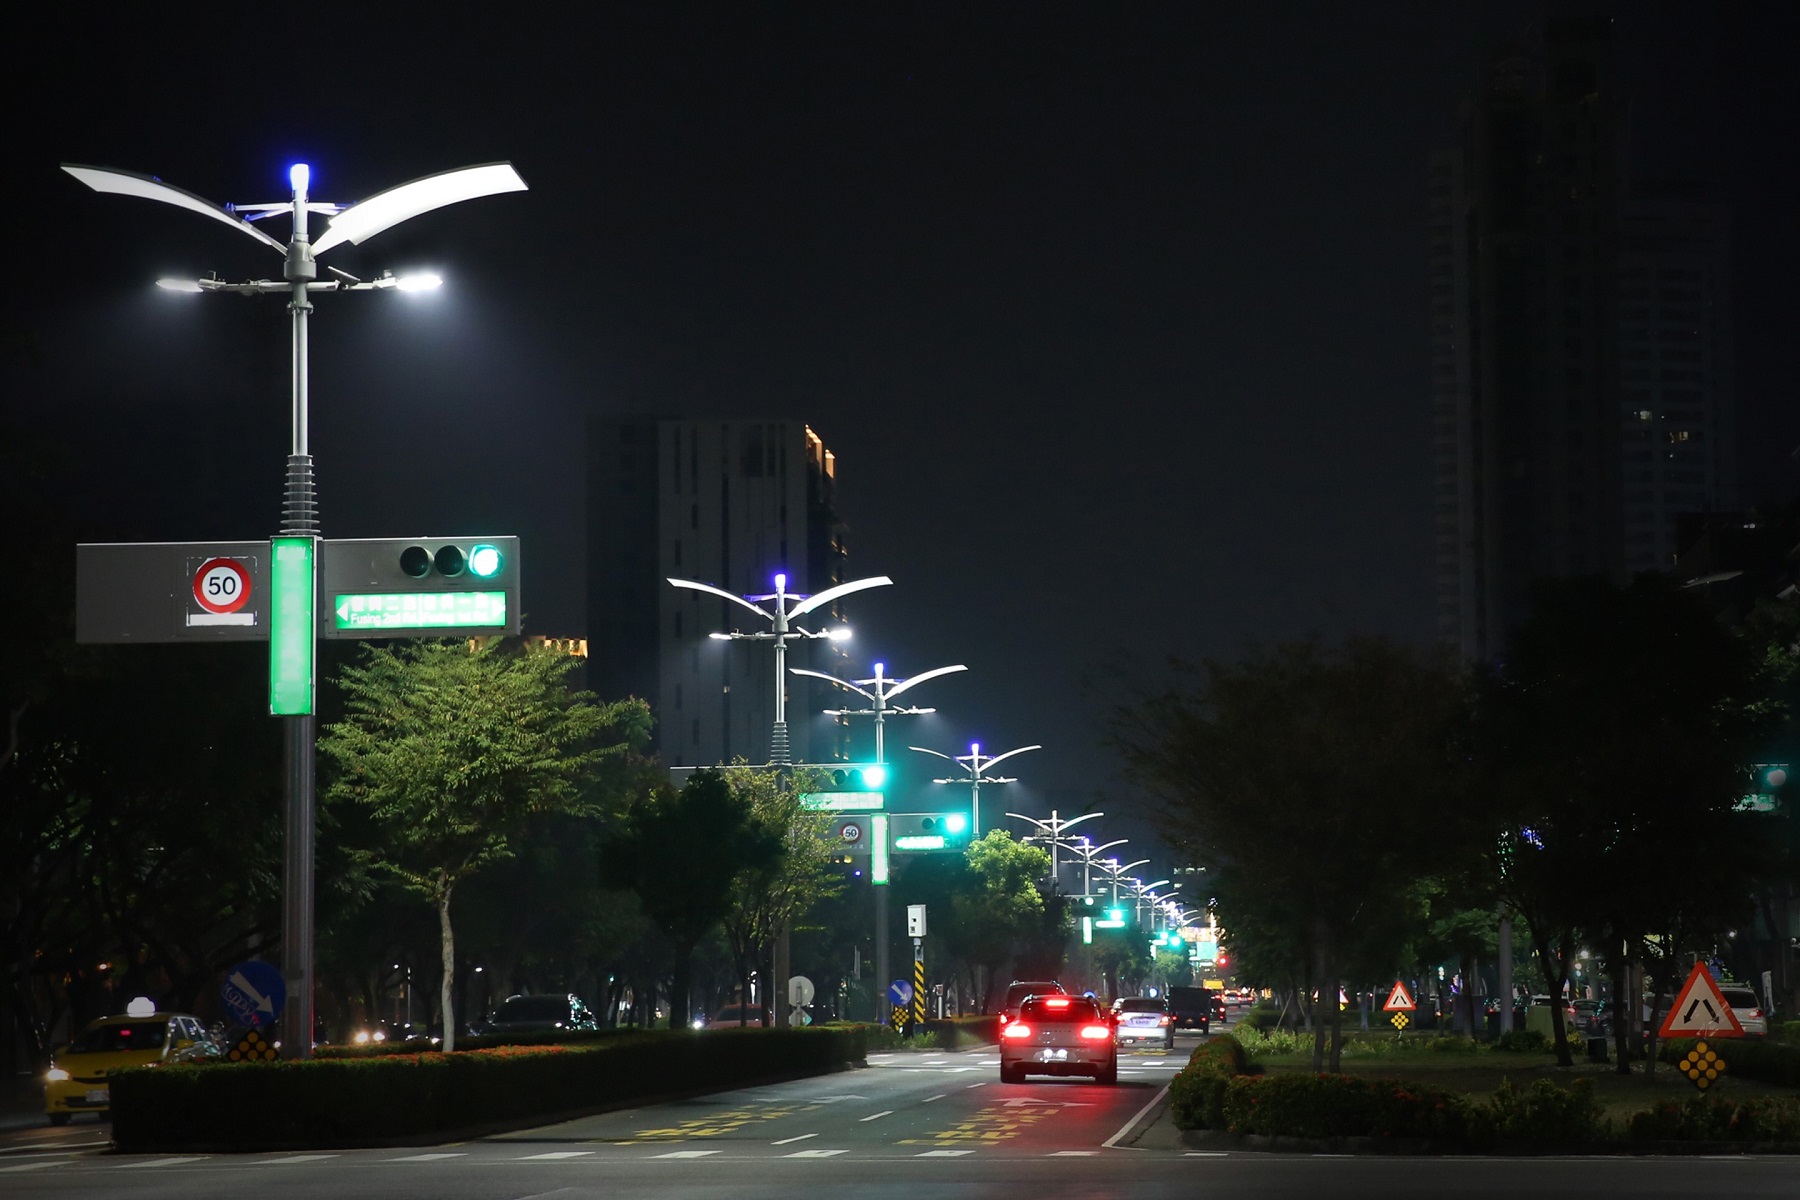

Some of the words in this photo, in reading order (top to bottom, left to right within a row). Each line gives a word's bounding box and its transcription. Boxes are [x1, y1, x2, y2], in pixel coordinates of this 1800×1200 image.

[208, 576, 236, 595] 50
[350, 613, 381, 626] Fusing
[845, 829, 857, 838] 50
